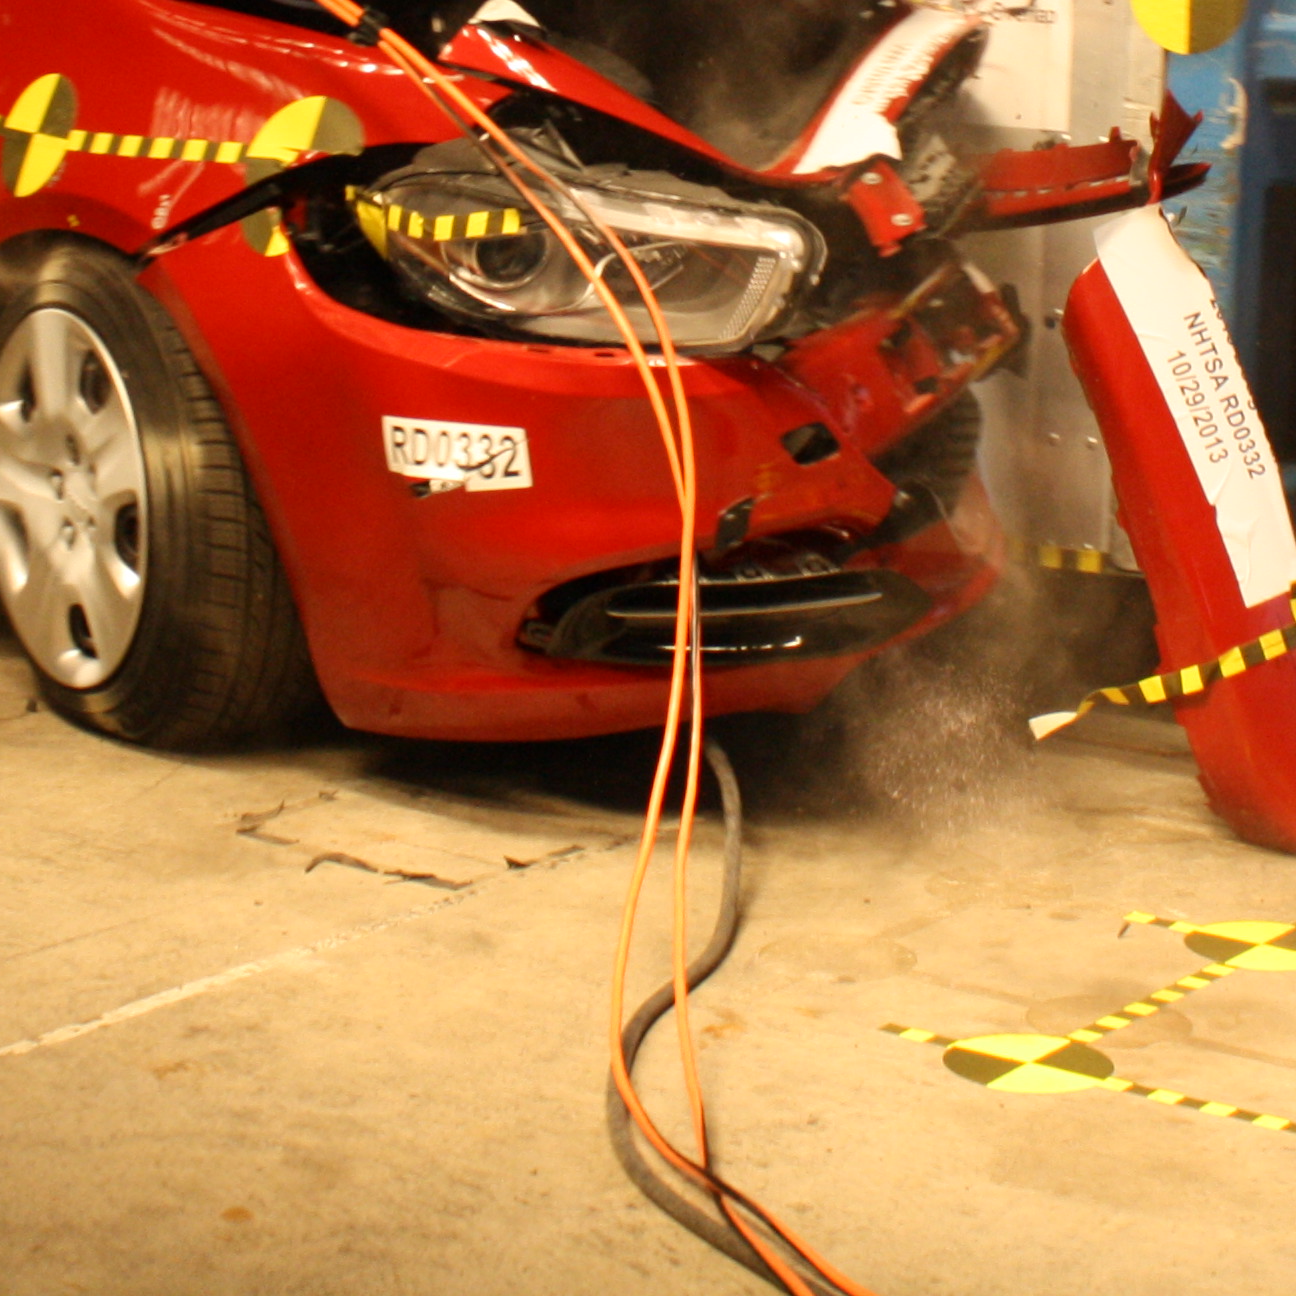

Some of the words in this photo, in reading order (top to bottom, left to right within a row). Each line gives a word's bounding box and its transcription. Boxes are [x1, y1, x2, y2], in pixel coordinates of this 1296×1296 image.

[1167, 350, 1229, 463] 10/29/2013
[1184, 311, 1229, 391] NHTSA
[1219, 394, 1266, 479] RD0332
[390, 426, 522, 479] RD0332
